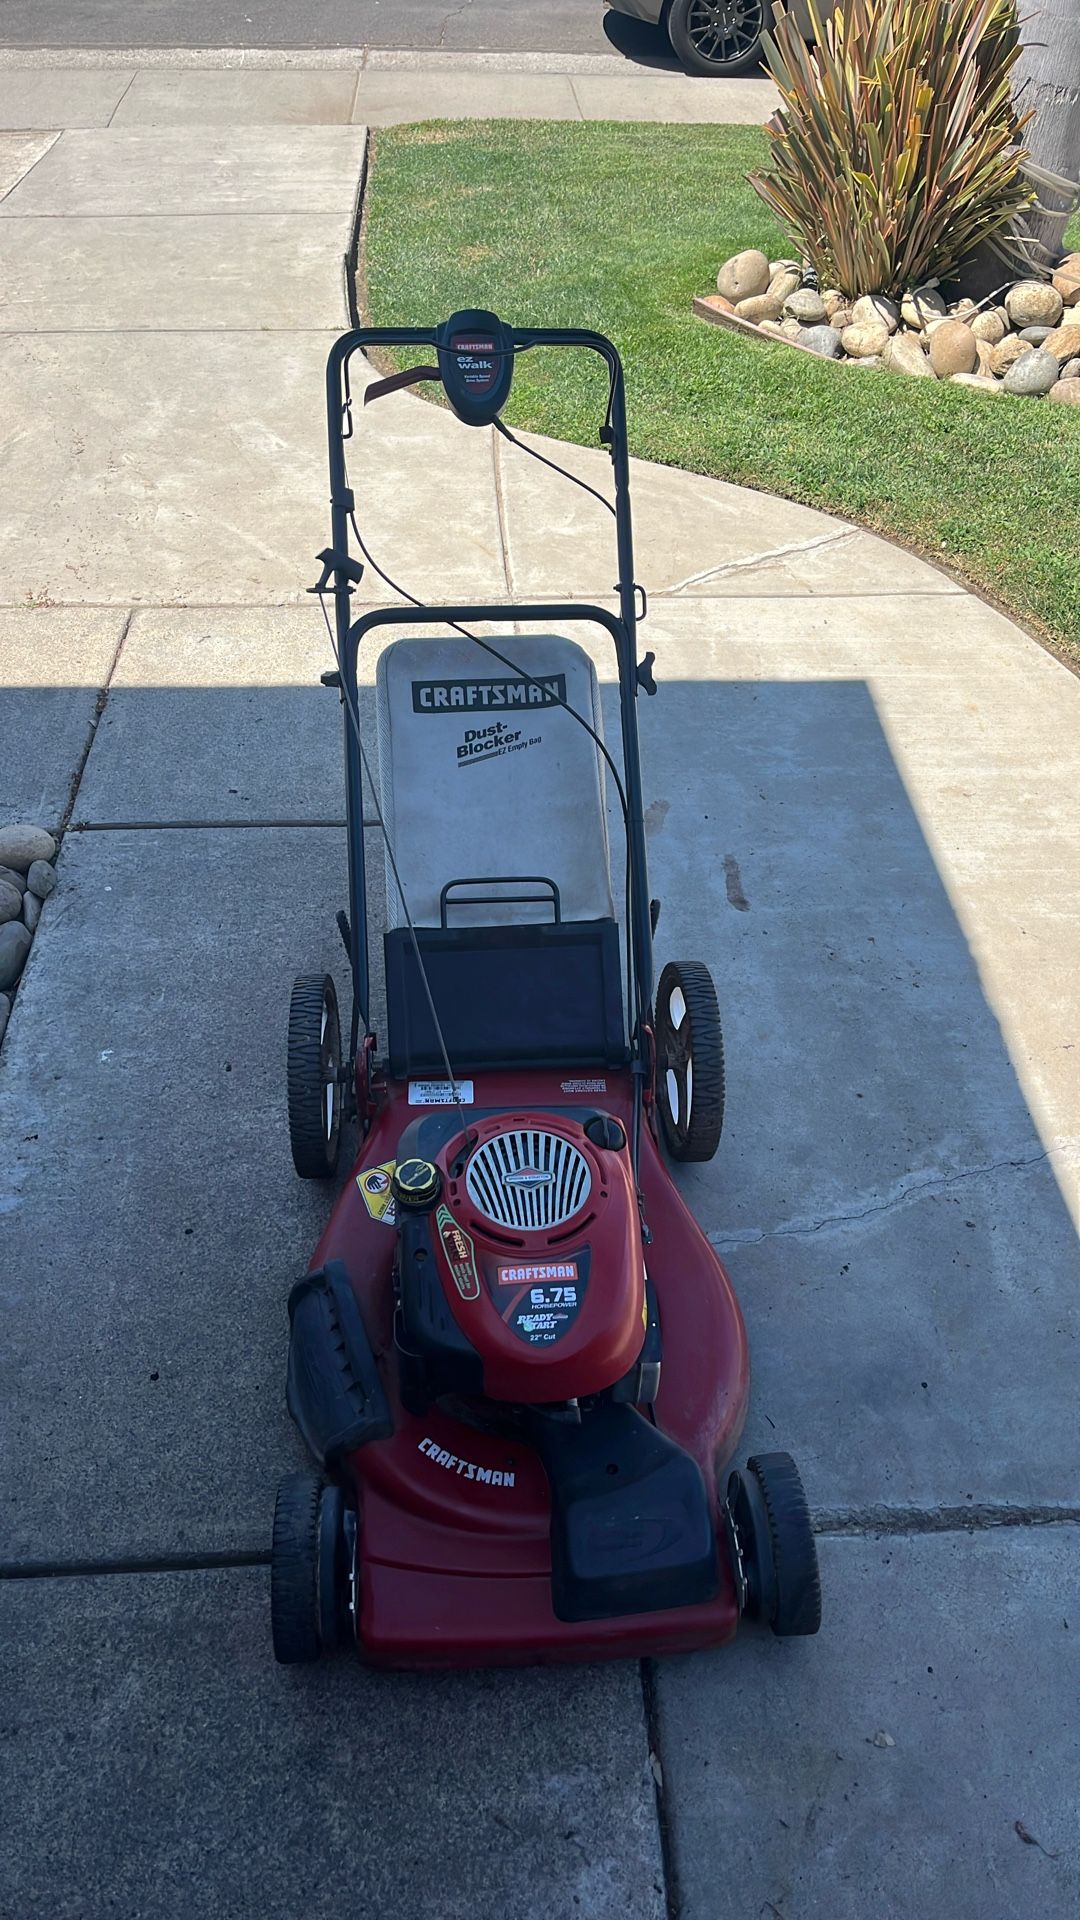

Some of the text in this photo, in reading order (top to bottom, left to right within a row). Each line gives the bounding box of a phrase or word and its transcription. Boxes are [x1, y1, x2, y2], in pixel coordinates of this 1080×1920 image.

[458, 361, 493, 369] walk
[419, 681, 560, 708] CRAFTSMAN
[464, 721, 508, 743] Dust-
[456, 730, 522, 759] Blocker
[507, 740, 528, 754] Empty
[529, 736, 542, 747] Bag
[452, 1229, 468, 1259] FRESH
[501, 1265, 575, 1281] CRAFTSMAN
[530, 1286, 577, 1304] 6.75
[531, 1302, 577, 1310] HORSEPOWER
[517, 1313, 554, 1325] READY
[543, 1333, 556, 1341] Cut
[418, 1437, 515, 1488] CRAFTSMAN
